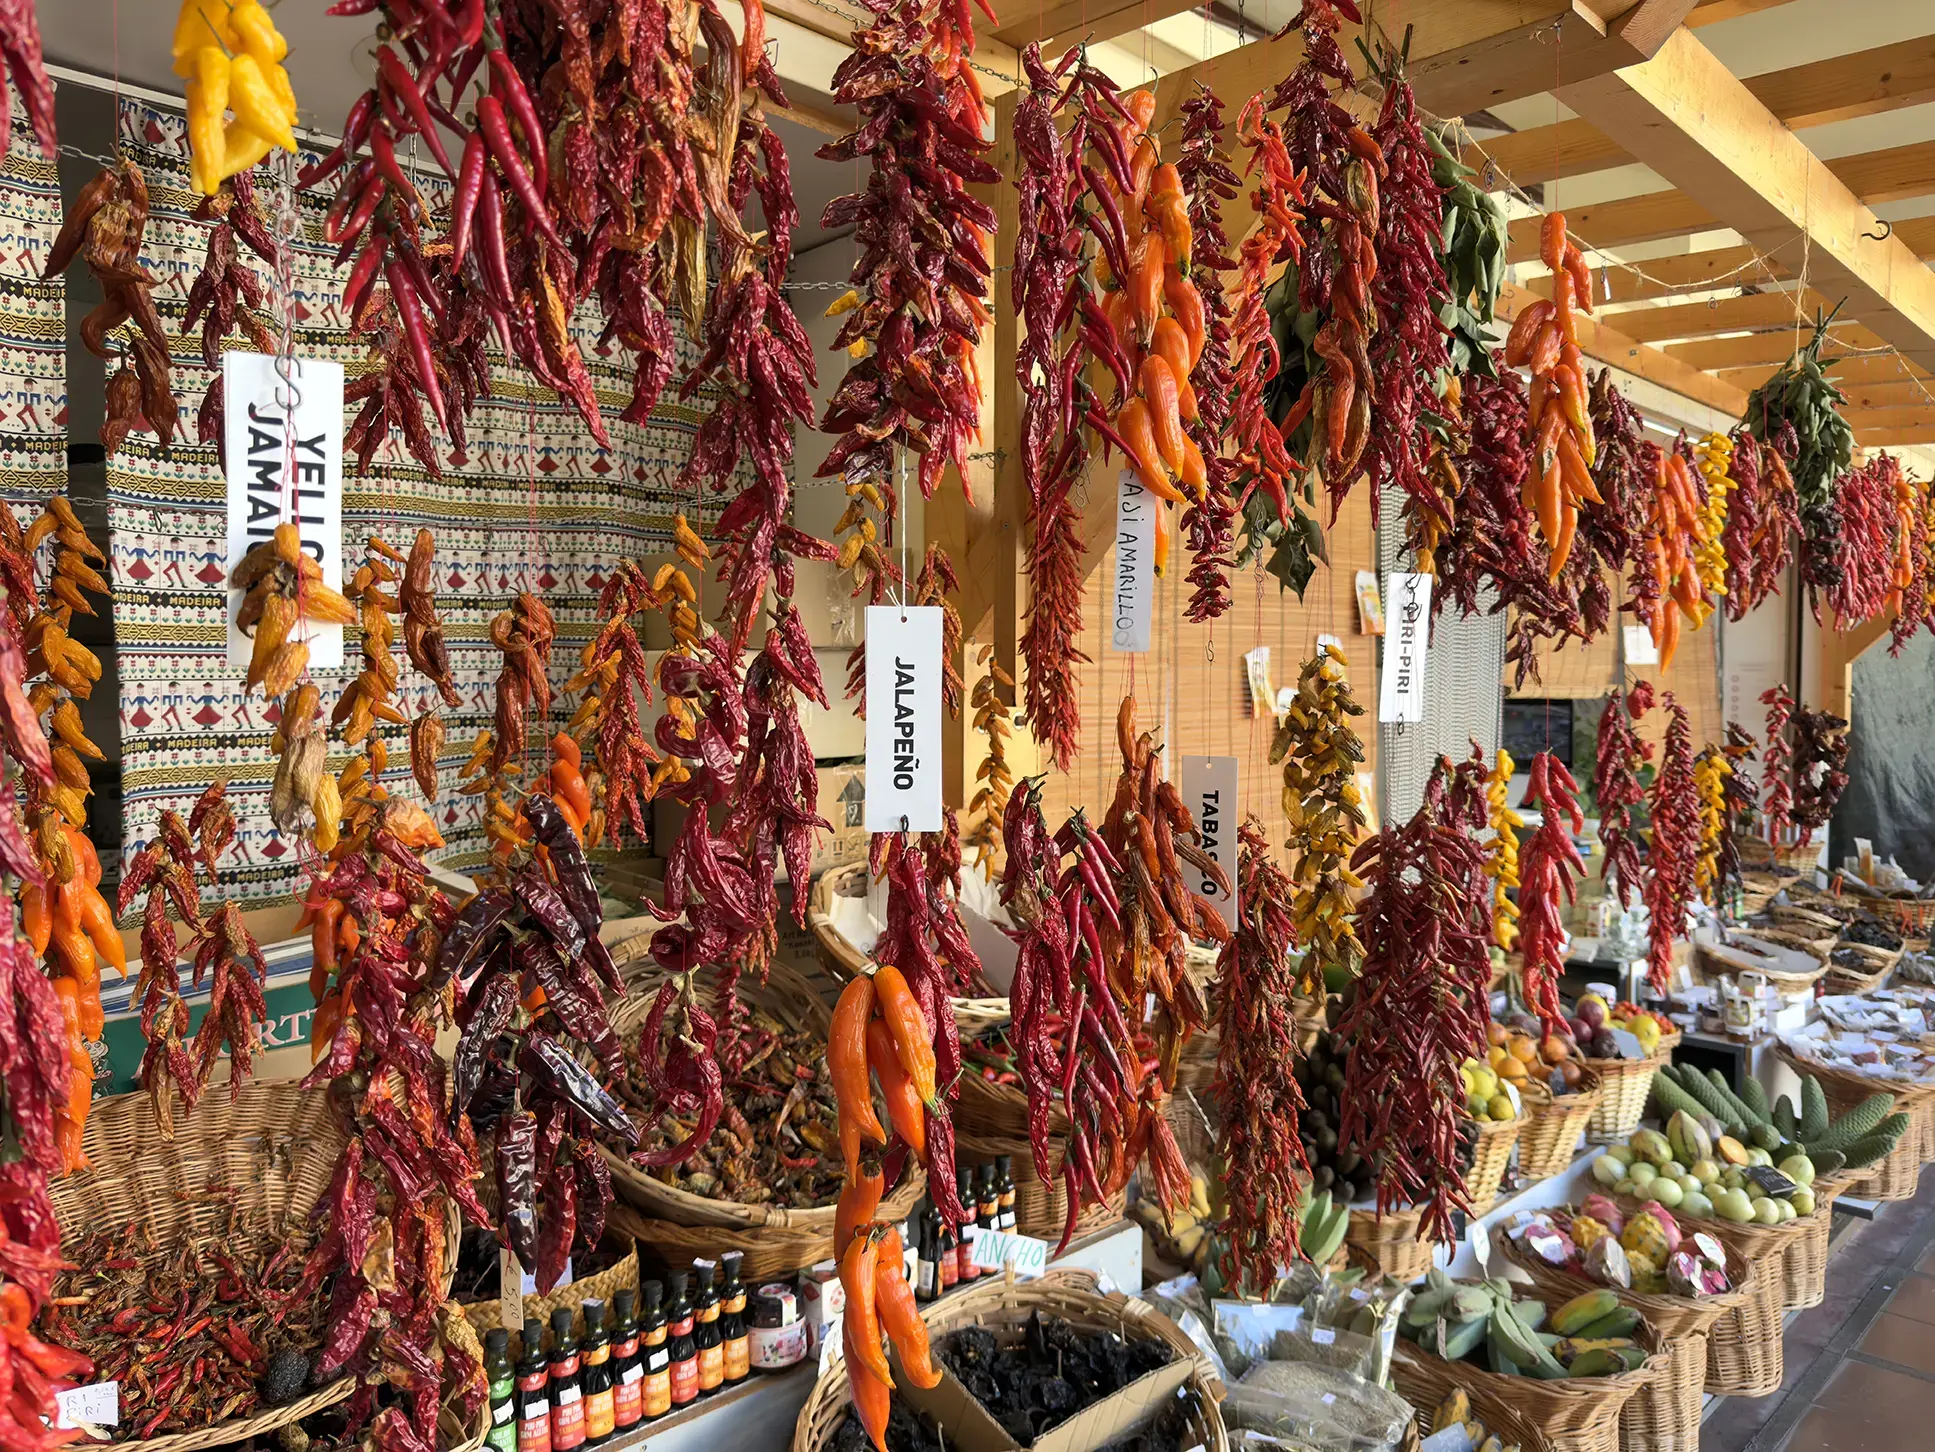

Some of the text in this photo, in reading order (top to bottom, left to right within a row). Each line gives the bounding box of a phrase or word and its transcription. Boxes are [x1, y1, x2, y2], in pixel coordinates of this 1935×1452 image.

[23, 286, 67, 300] MADEIR
[25, 440, 68, 451] MADEIR
[119, 443, 150, 457] DEIRA
[246, 402, 283, 625] JAMAI
[292, 433, 326, 571] YELL
[112, 592, 149, 604] MDEIRA
[169, 595, 221, 607] MADEIRA
[121, 735, 273, 755] DEIRA MADEIRA MADEI
[893, 655, 920, 790] JALAPEÑO
[1201, 790, 1220, 896] TABAO
